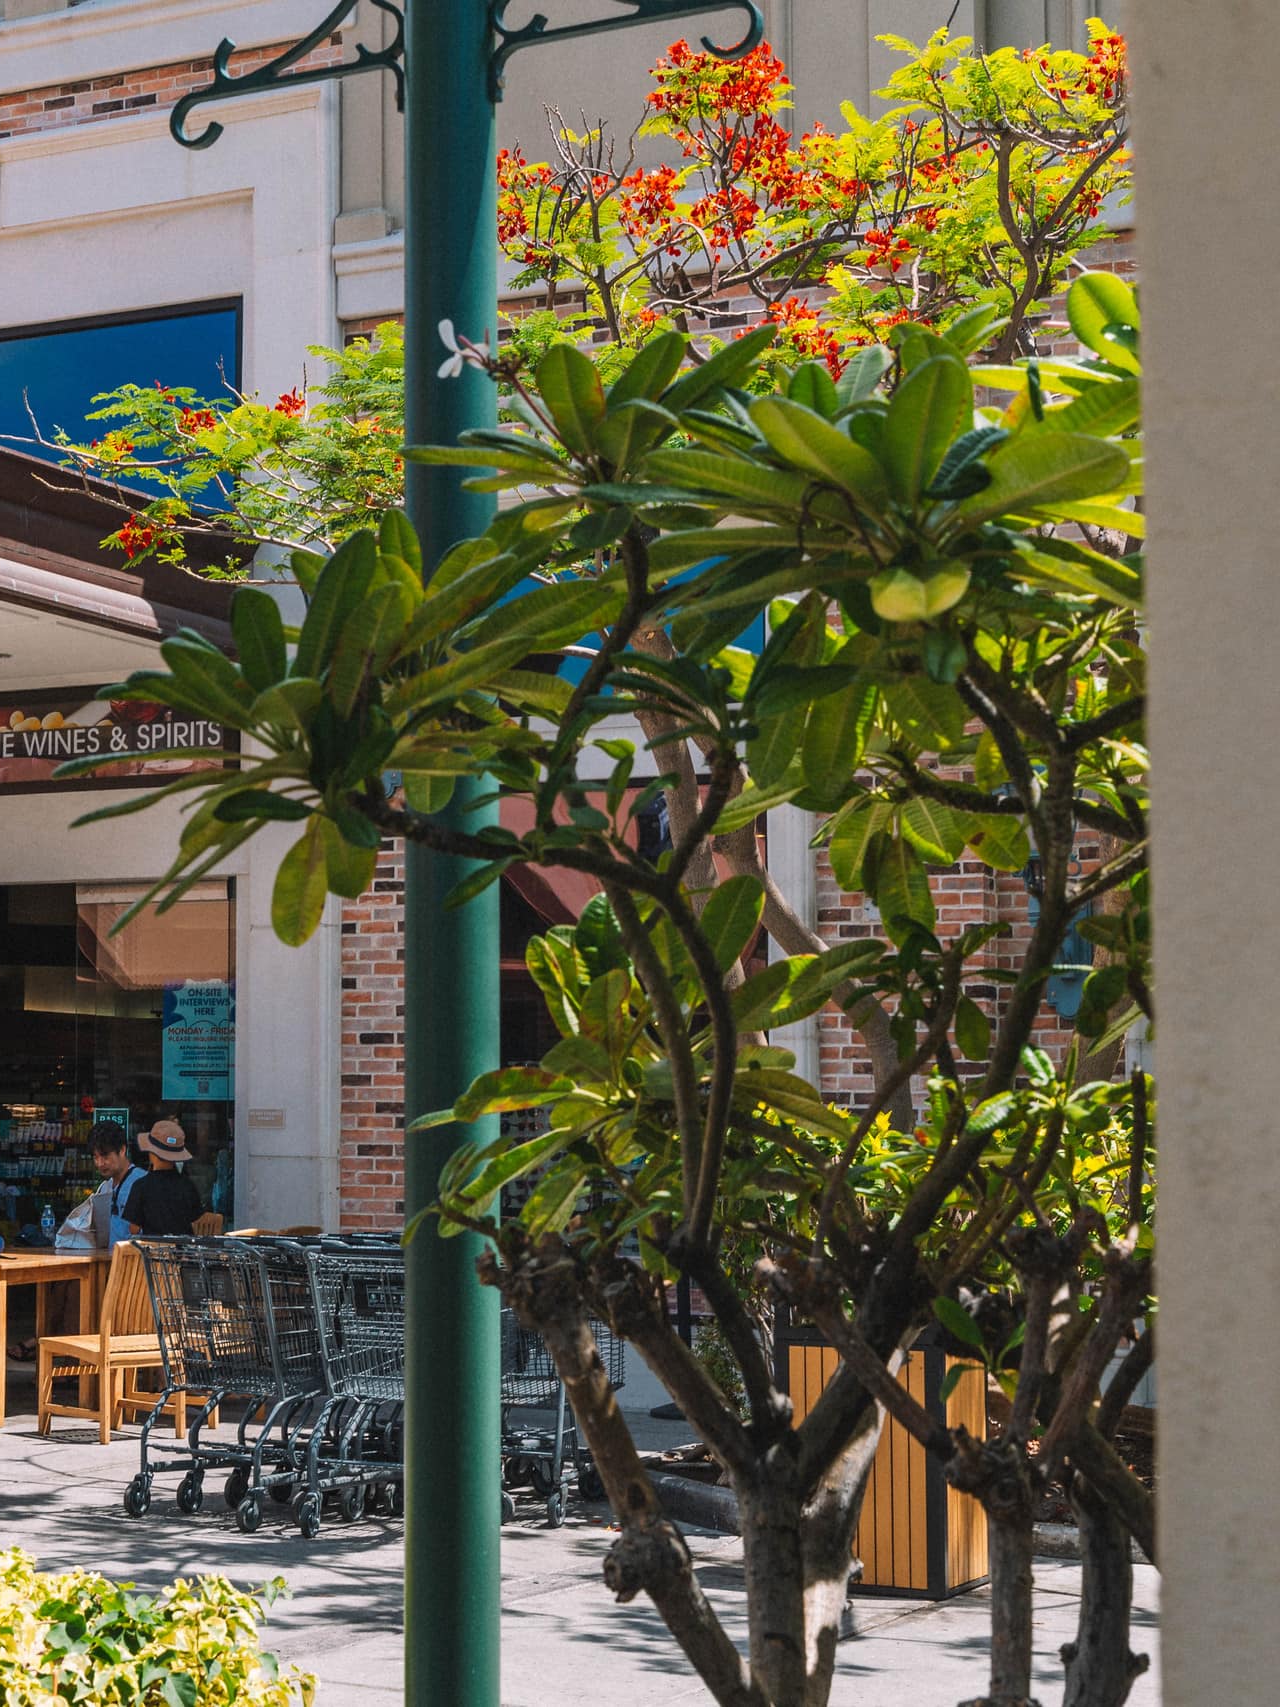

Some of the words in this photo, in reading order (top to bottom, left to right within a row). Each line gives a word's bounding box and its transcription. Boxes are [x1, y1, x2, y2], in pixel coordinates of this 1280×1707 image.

[23, 729, 100, 757] WINES
[109, 725, 128, 751] &
[136, 720, 221, 750] SPIRITS
[187, 988, 222, 997] ON-SITE
[179, 998, 230, 1006] INTERVIEWS
[194, 1007, 216, 1016] HERE
[168, 1027, 202, 1035] MONDAY
